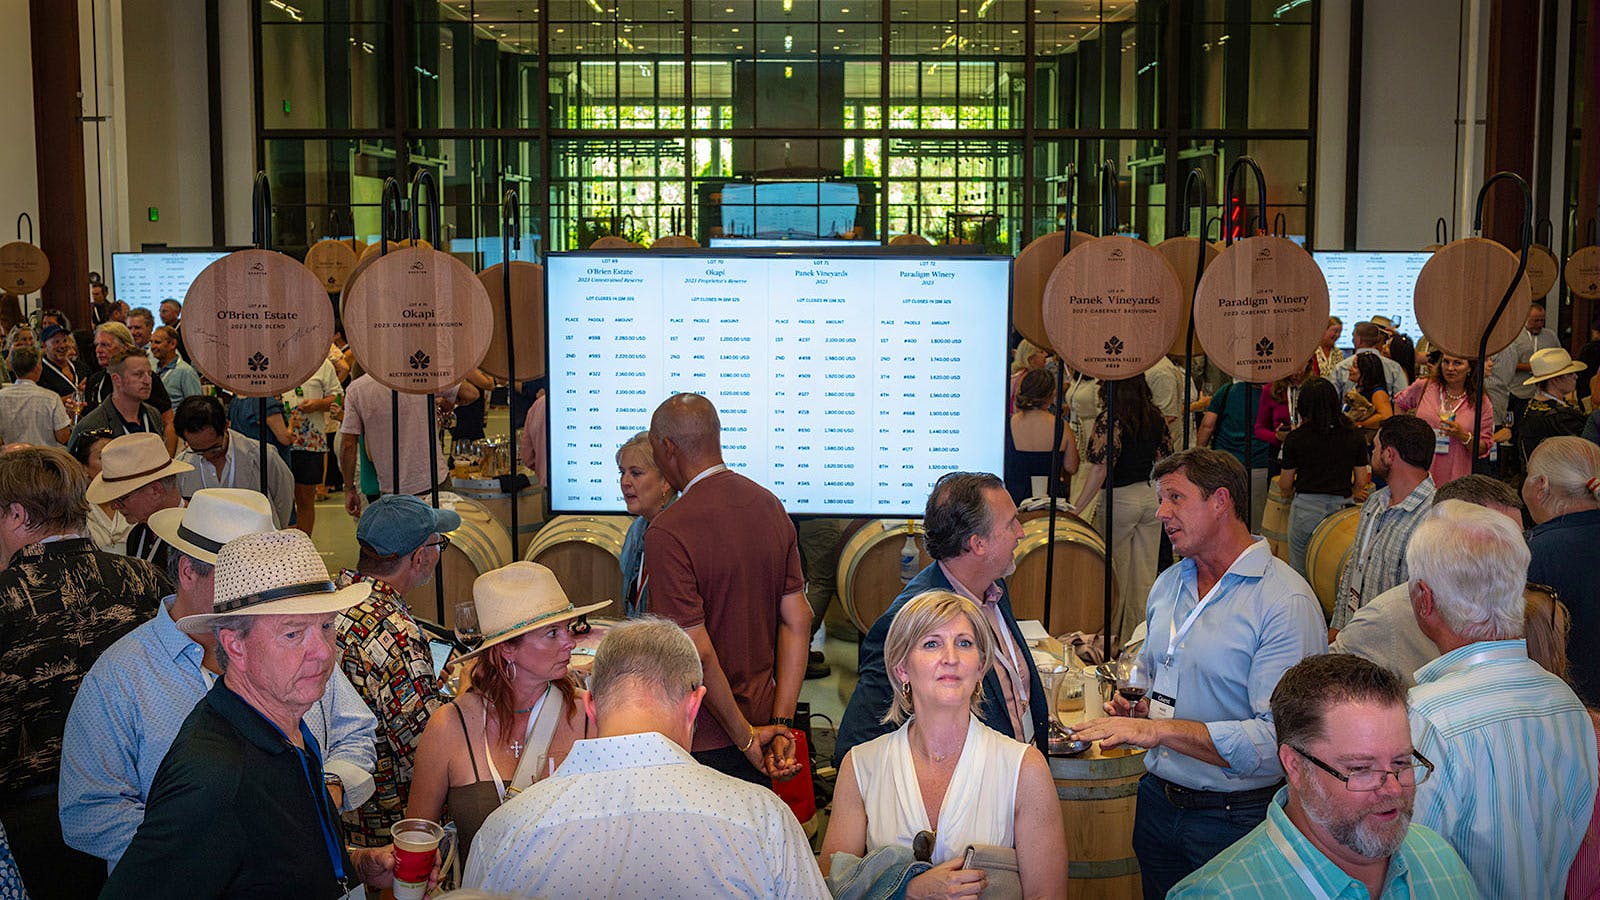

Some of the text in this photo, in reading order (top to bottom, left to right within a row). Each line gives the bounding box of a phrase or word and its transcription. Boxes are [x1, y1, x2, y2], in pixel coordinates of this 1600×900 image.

[705, 269, 725, 277] Okapi
[932, 271, 955, 279] Winery
[1069, 296, 1160, 306] Panek Vineyards
[1218, 295, 1309, 308] Paradigm Winery
[216, 310, 298, 320] O'Brien Estate
[402, 309, 435, 320] Okapi
[1158, 695, 1170, 704] Guest
